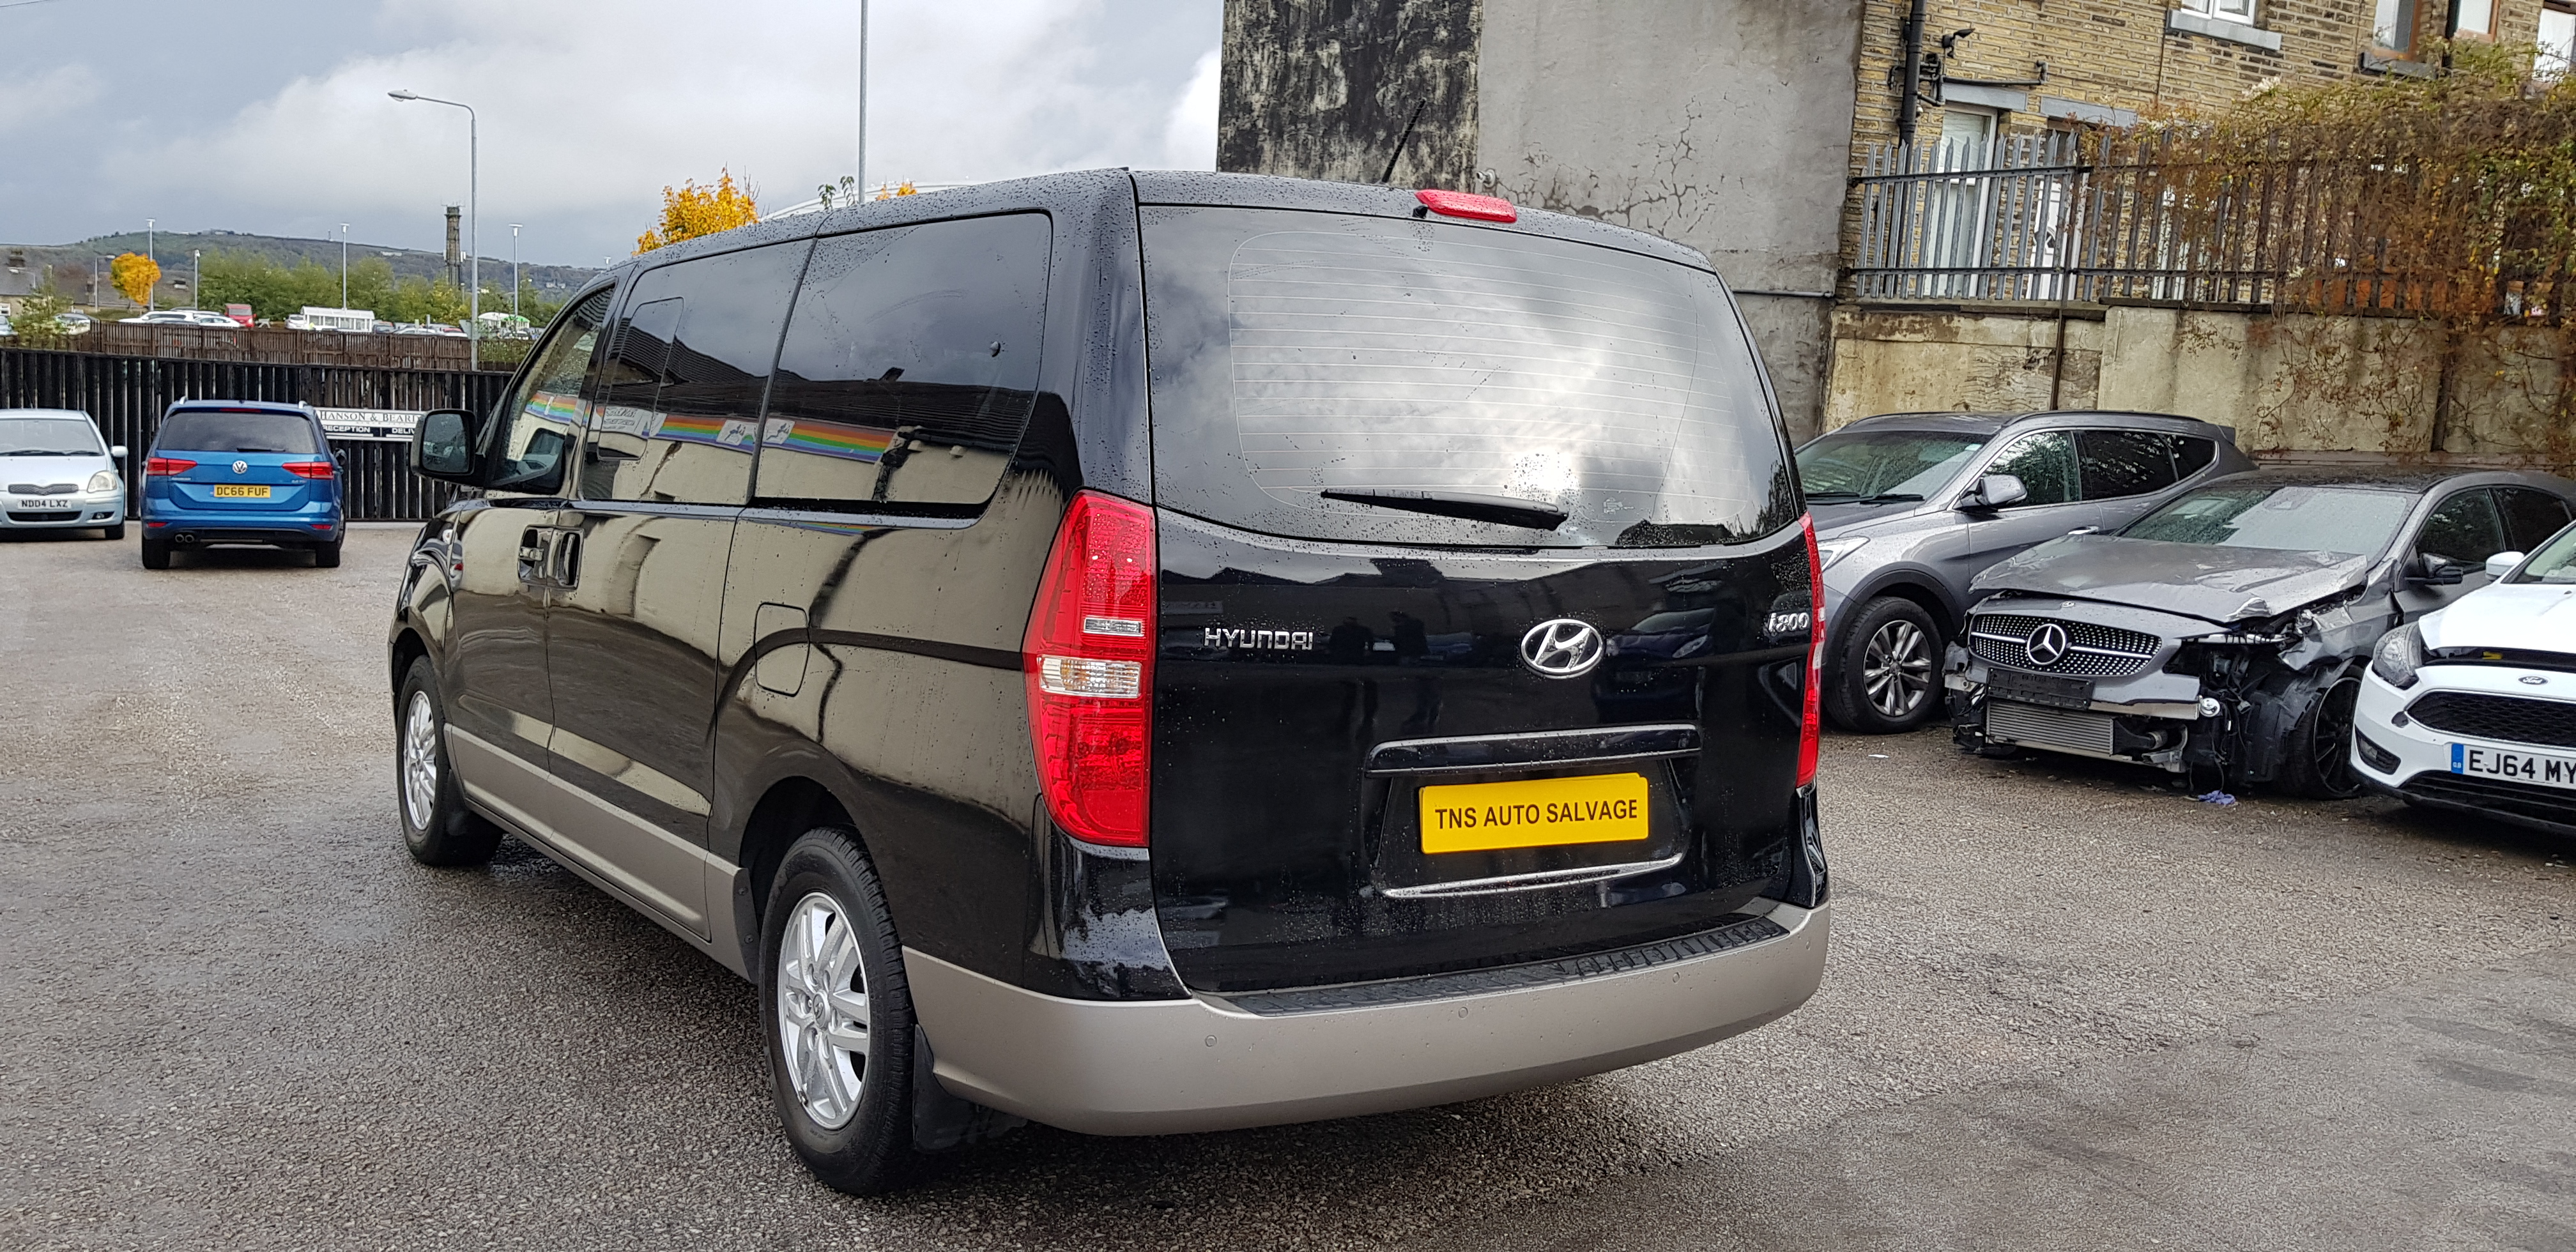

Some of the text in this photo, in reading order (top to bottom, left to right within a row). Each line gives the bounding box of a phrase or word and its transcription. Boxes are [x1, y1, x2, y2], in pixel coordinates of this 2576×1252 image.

[320, 411, 365, 420] HANSON
[371, 413, 378, 422] &
[217, 487, 268, 496] DC66 FUF
[49, 500, 68, 508] LXZ
[1204, 627, 1313, 650] HYUNDAI
[2469, 750, 2576, 784] EJ64 MY
[1435, 799, 1637, 829] TNS AUTO SALVAGE
